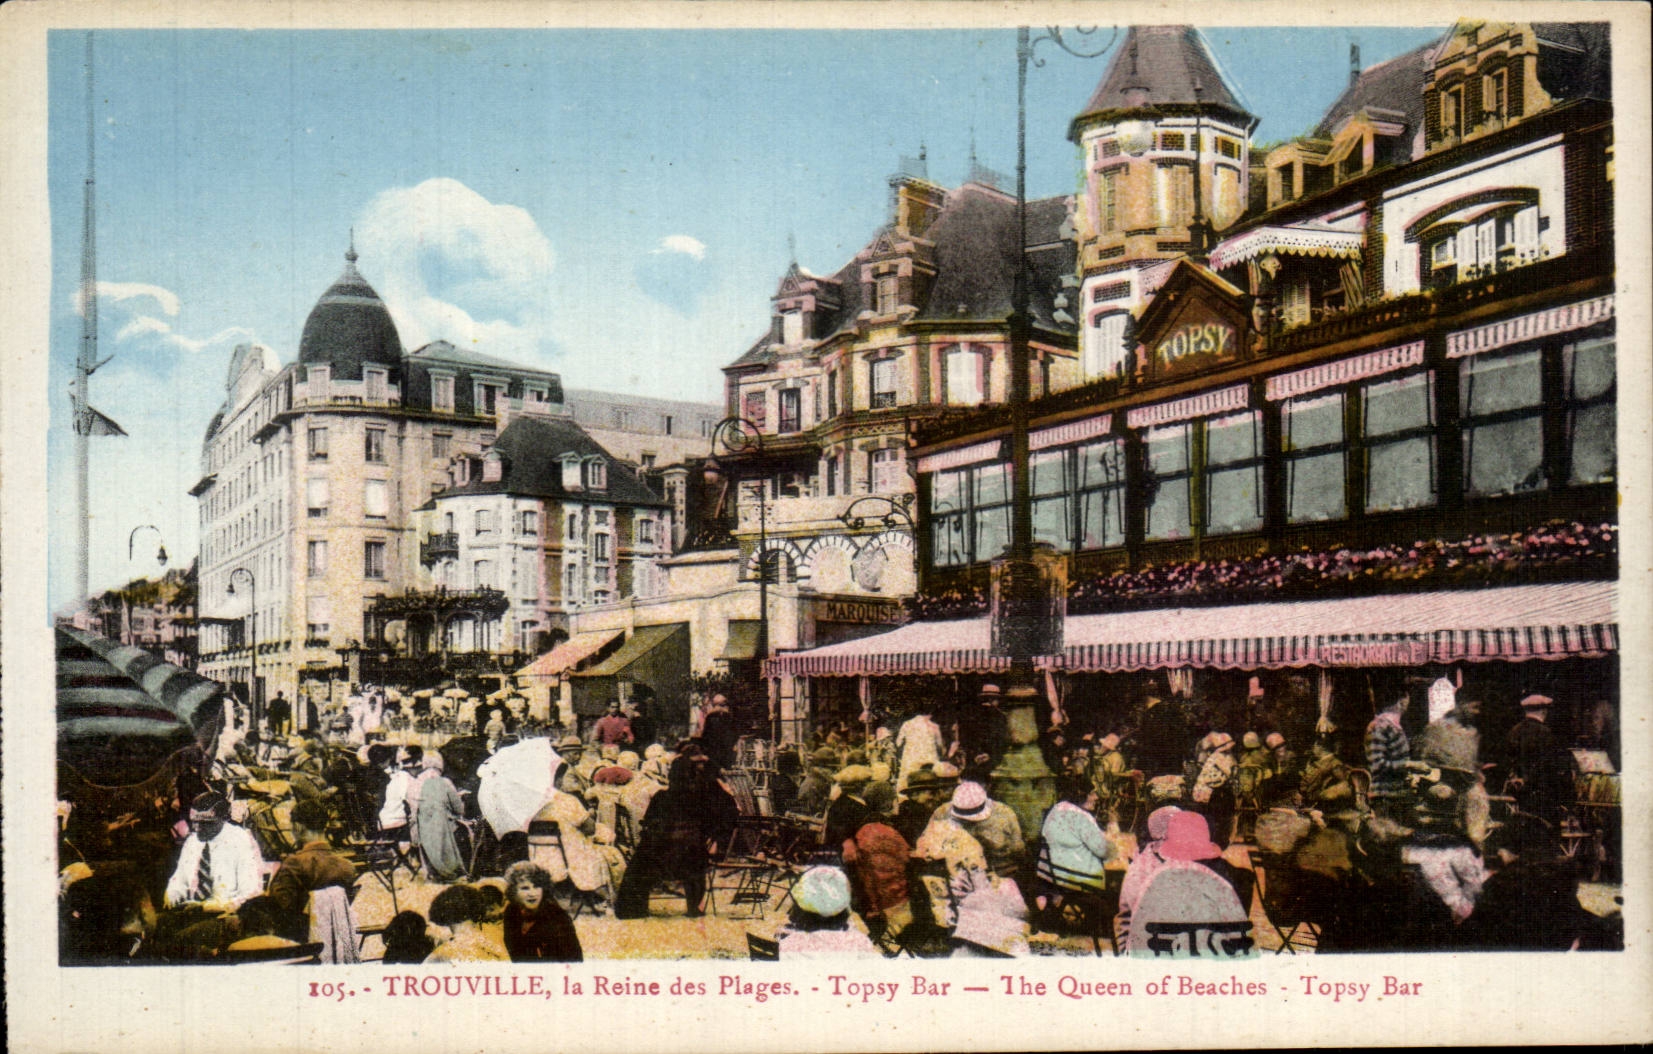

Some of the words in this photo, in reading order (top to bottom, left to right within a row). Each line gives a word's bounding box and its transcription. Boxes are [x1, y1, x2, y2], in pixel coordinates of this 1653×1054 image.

[1158, 322, 1232, 366] TOPSY
[825, 601, 898, 622] MARQUISE
[1321, 642, 1397, 663] RESTAURANT
